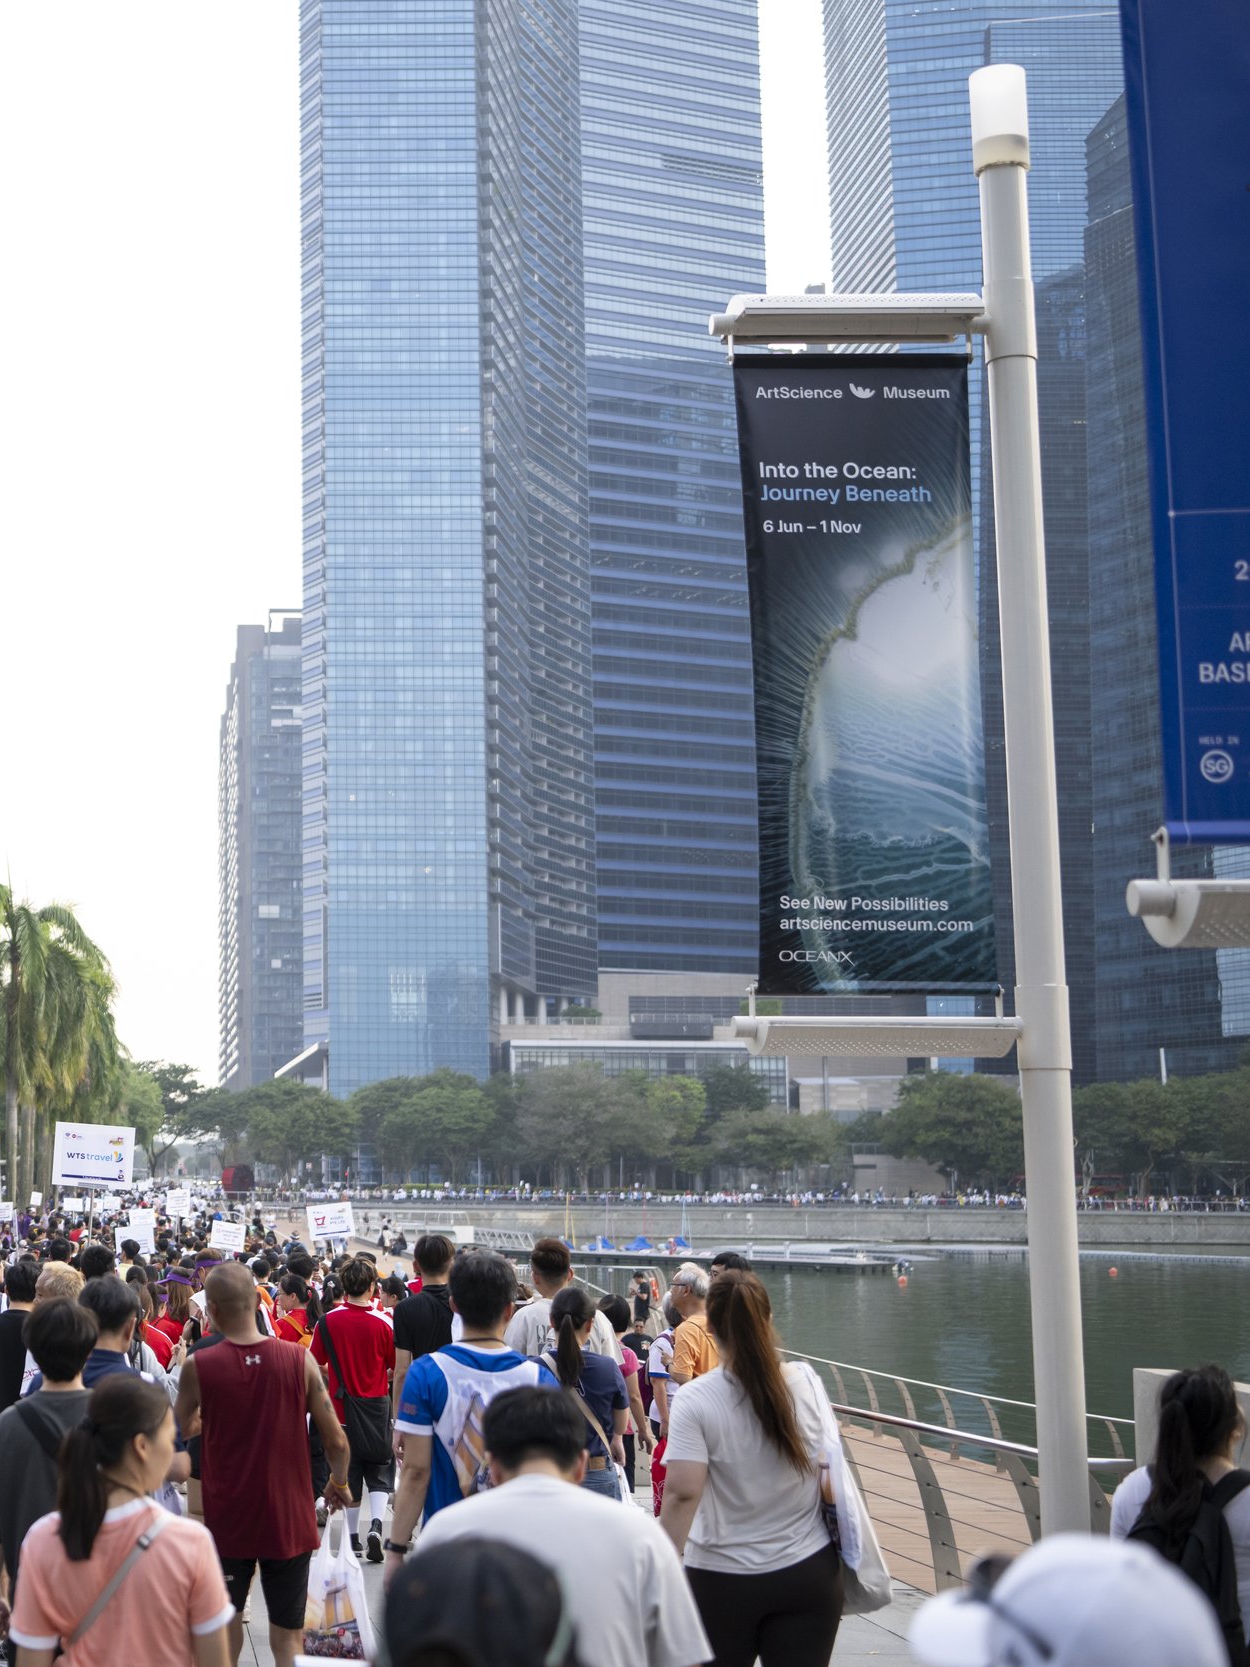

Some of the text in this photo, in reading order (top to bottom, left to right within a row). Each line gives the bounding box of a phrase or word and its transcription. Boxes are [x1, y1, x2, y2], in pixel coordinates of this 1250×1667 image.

[755, 386, 950, 399] ArtScience Museum
[759, 462, 917, 480] Into the Ocean:
[760, 485, 932, 505] Journey Beneath
[763, 520, 774, 533] 6
[777, 520, 803, 533] Jun
[819, 520, 827, 533] 1
[830, 520, 862, 534] Nov
[780, 896, 949, 911] See New Possibilities
[779, 917, 974, 932] artsciencemuseum.com
[778, 950, 856, 966] OCEANX
